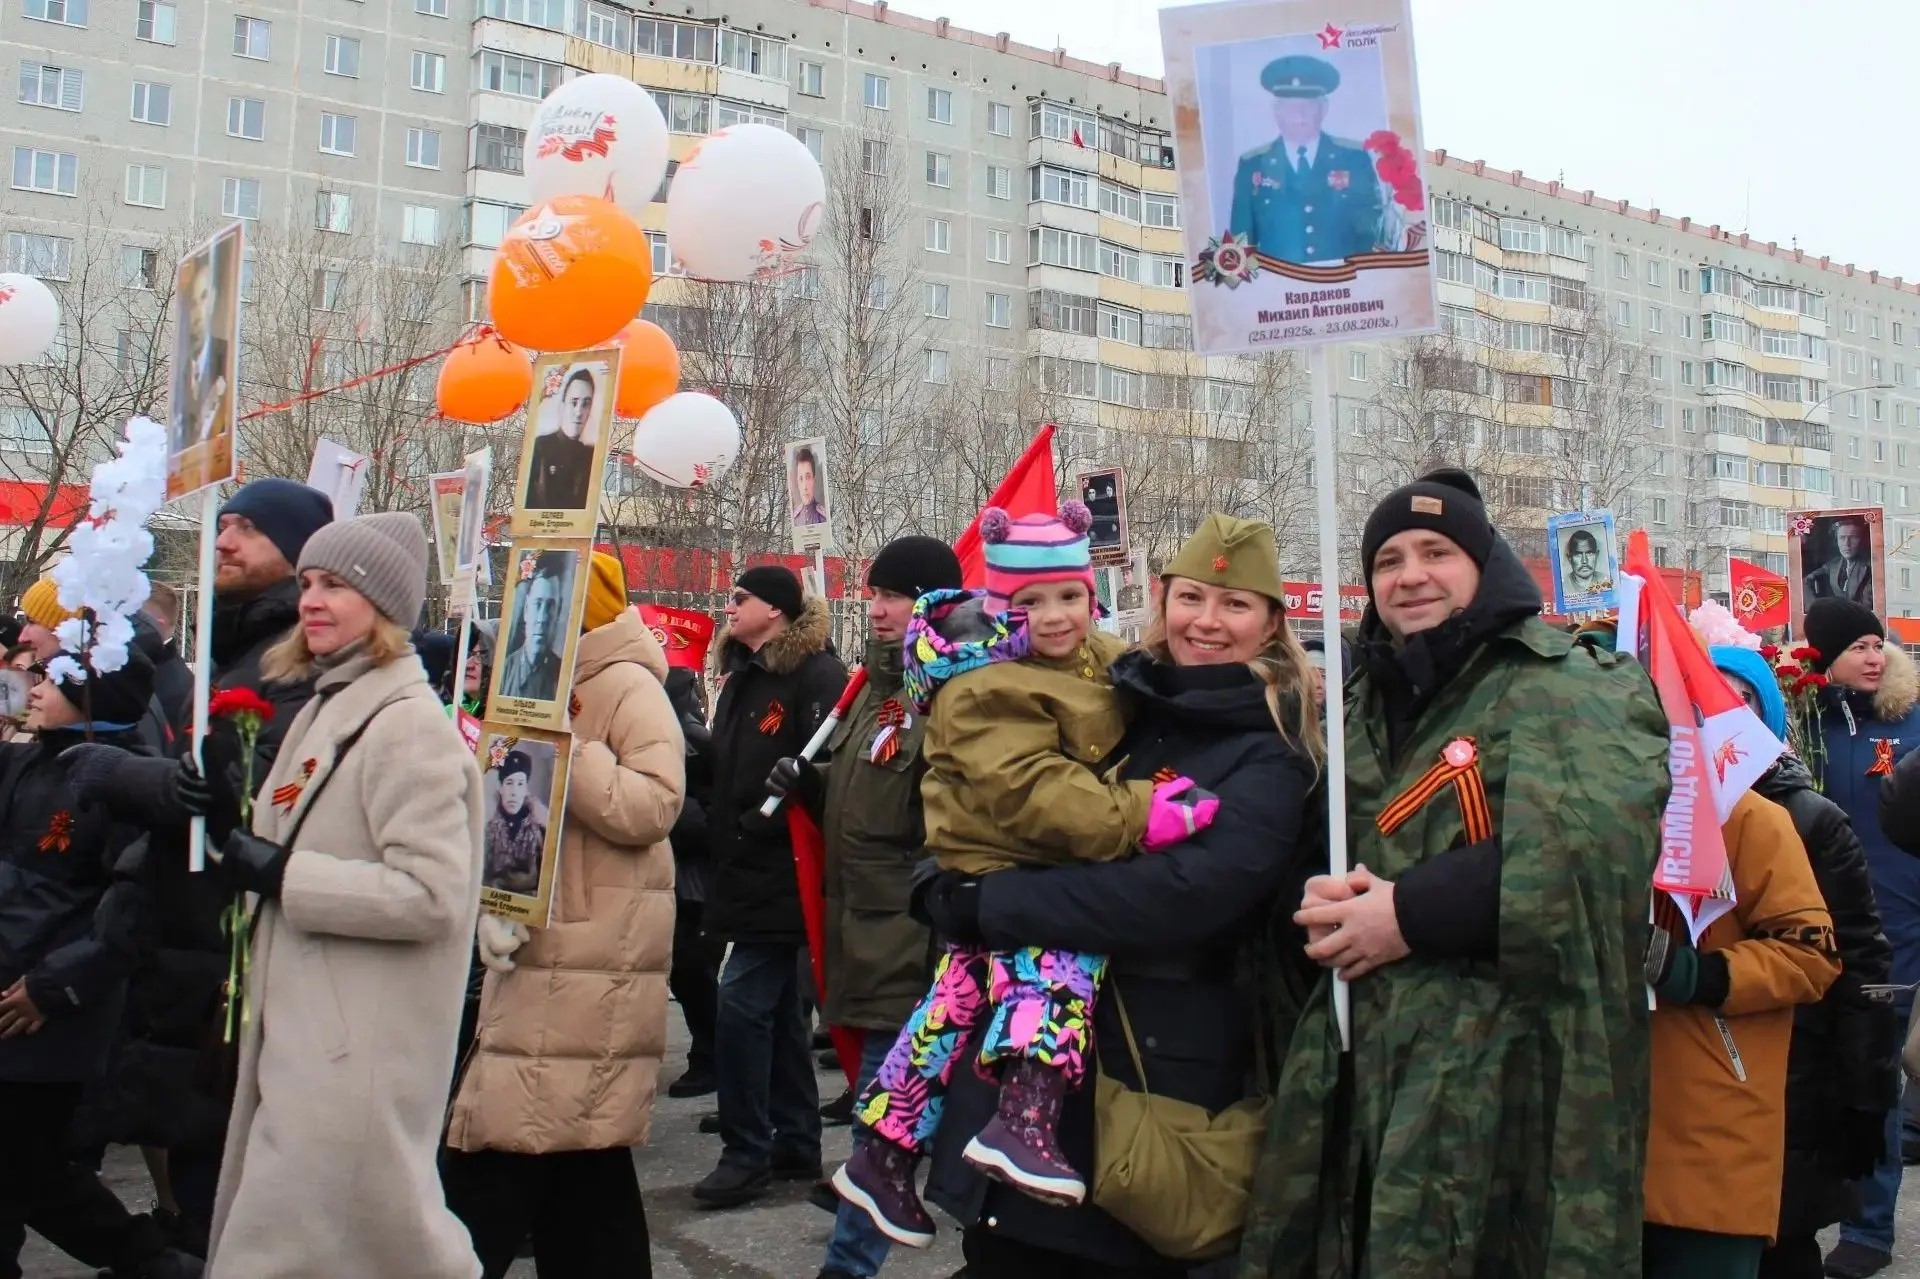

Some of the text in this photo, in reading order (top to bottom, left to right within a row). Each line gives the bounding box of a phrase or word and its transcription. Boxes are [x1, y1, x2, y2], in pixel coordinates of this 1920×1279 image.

[1347, 37, 1377, 48] ПОЛК
[1285, 288, 1351, 305] Кардаков
[1258, 300, 1384, 324] Михаил Антонович
